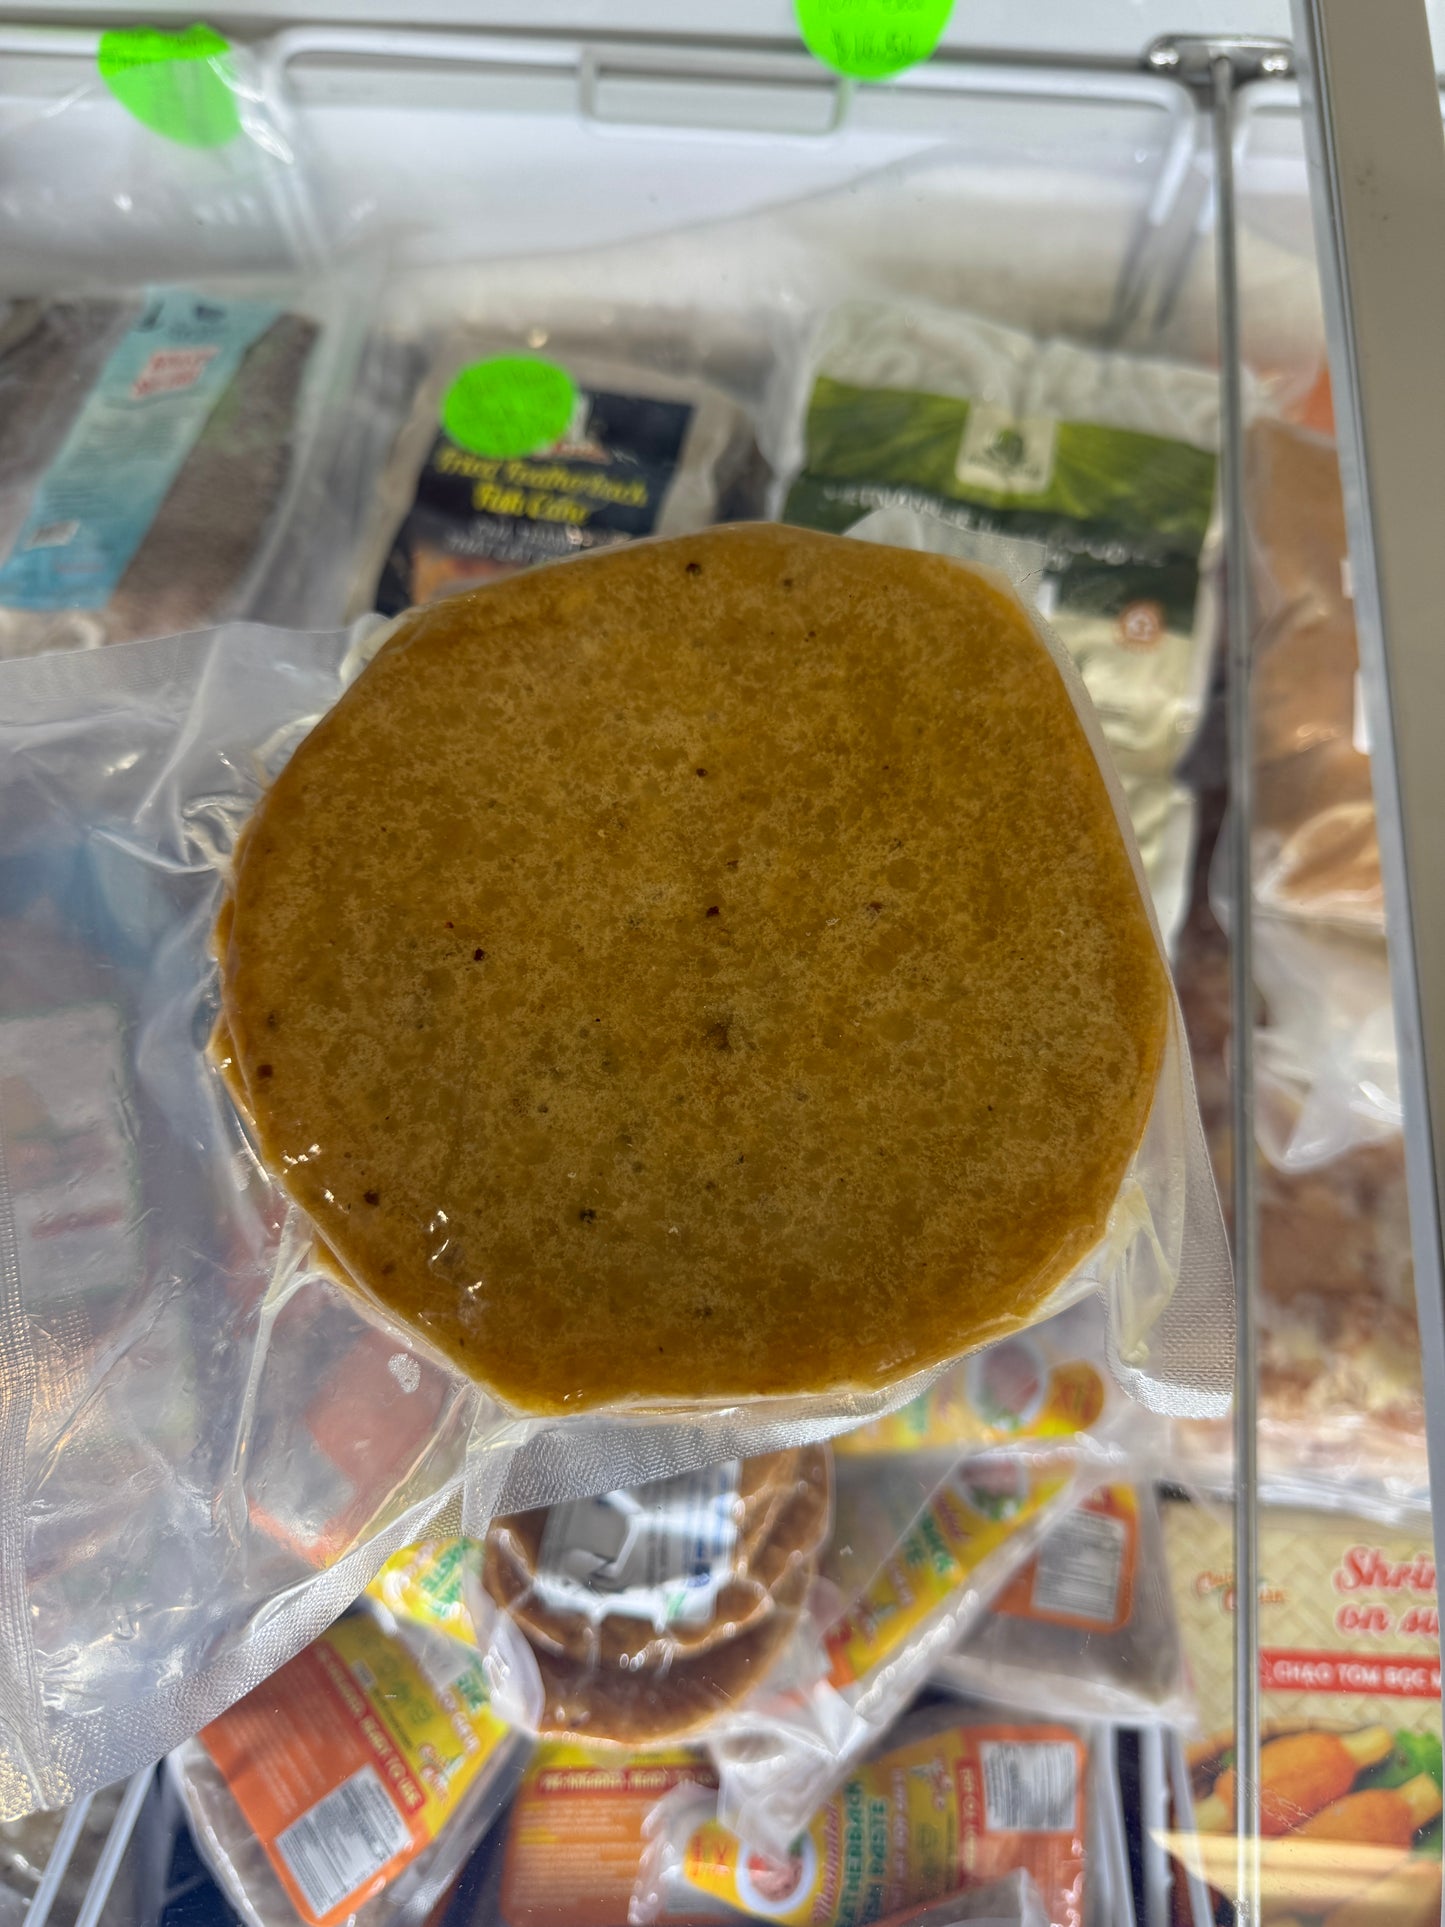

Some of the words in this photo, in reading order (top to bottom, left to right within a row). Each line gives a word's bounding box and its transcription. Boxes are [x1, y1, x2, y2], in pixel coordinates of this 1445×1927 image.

[1332, 1544, 1436, 1593] Shri
[1336, 1604, 1390, 1634] on
[1400, 1608, 1440, 1636] su
[839, 1780, 863, 1926] EATHERBACK
